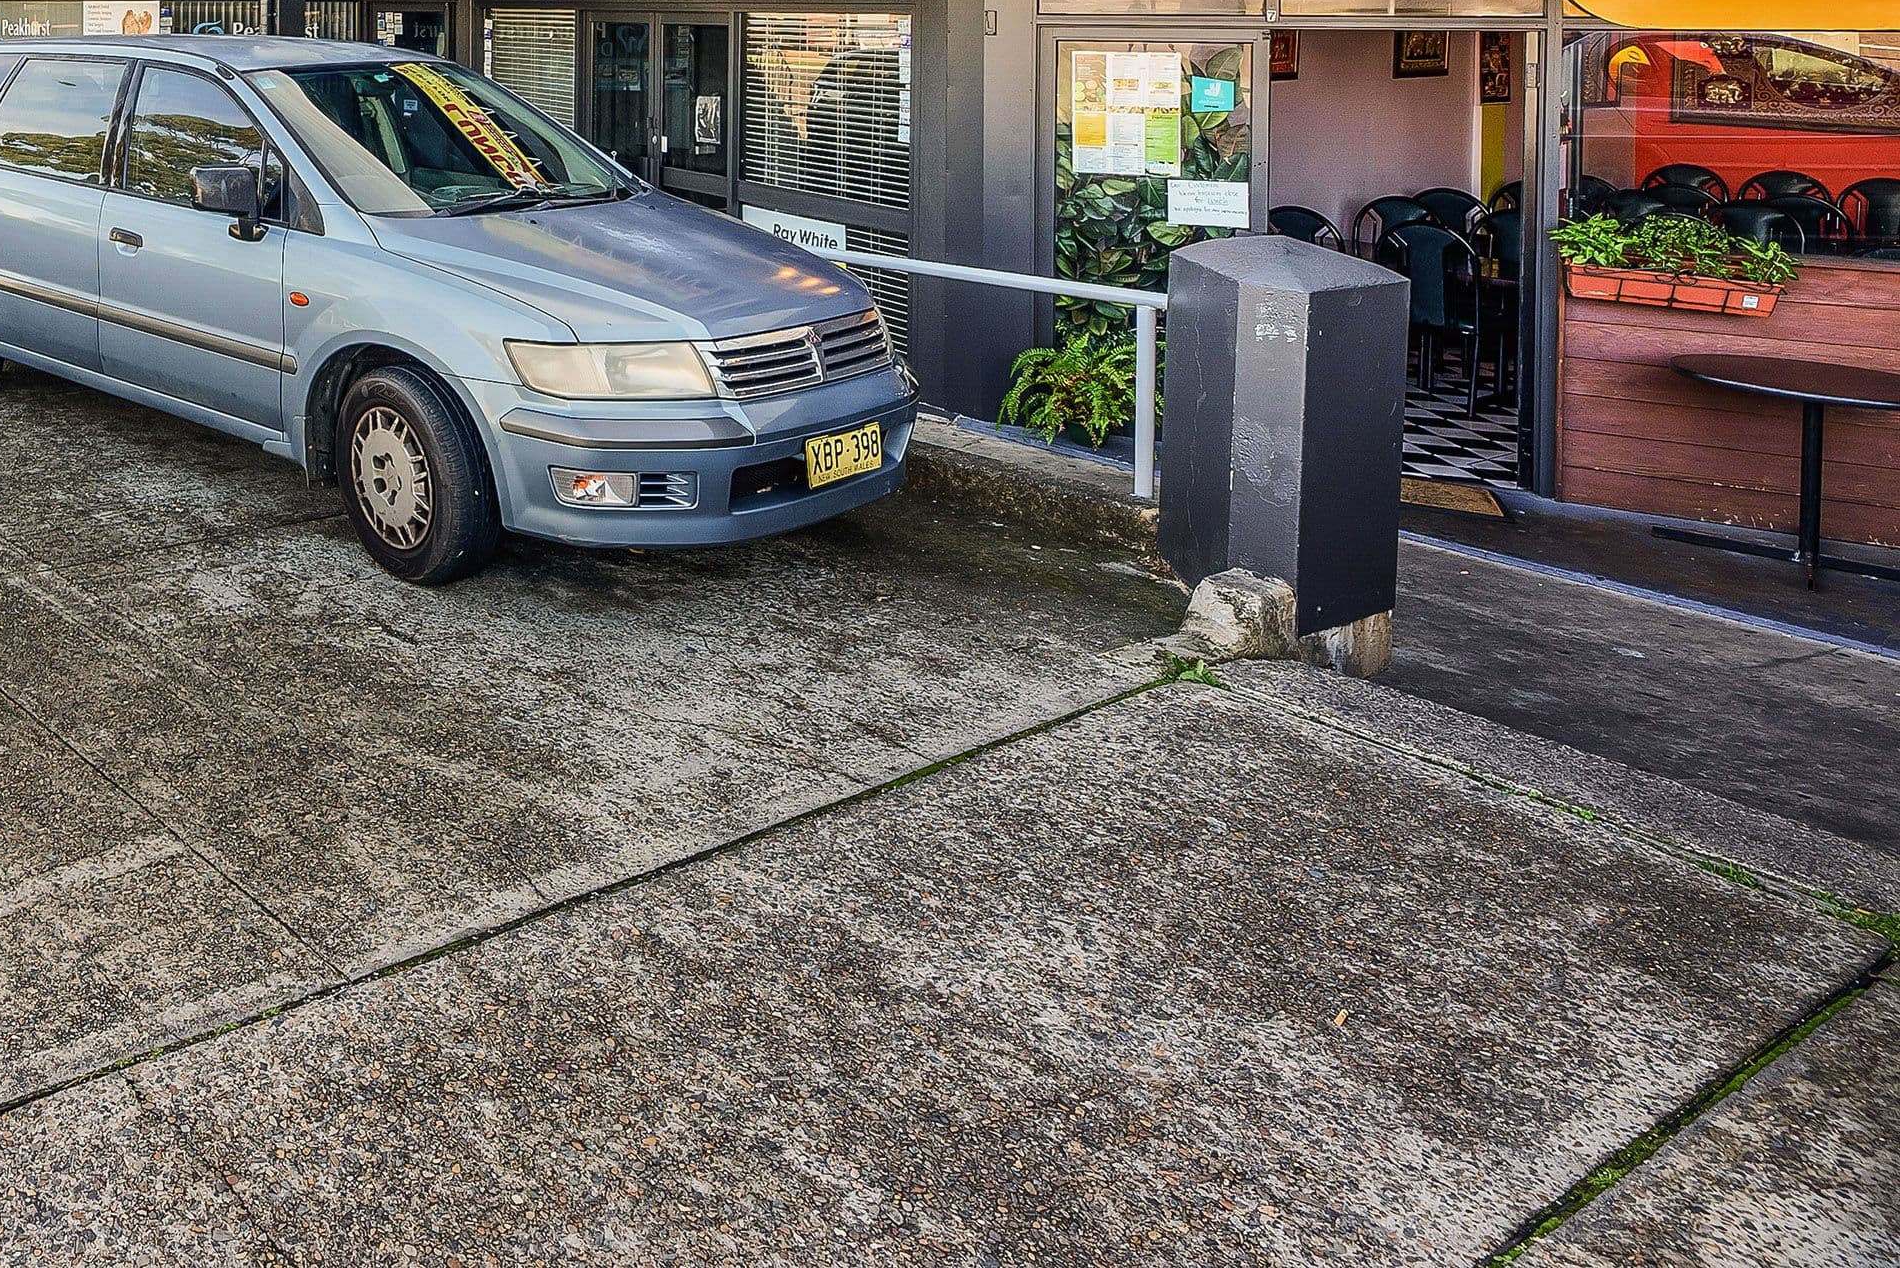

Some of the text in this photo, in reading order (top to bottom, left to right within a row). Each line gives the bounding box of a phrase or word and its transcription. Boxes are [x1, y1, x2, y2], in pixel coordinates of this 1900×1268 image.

[1268, 12, 1275, 20] 7
[1, 17, 51, 37] Peakhurst
[773, 223, 839, 250] Ray White
[833, 466, 852, 478] SOUTH
[854, 459, 874, 471] WALES
